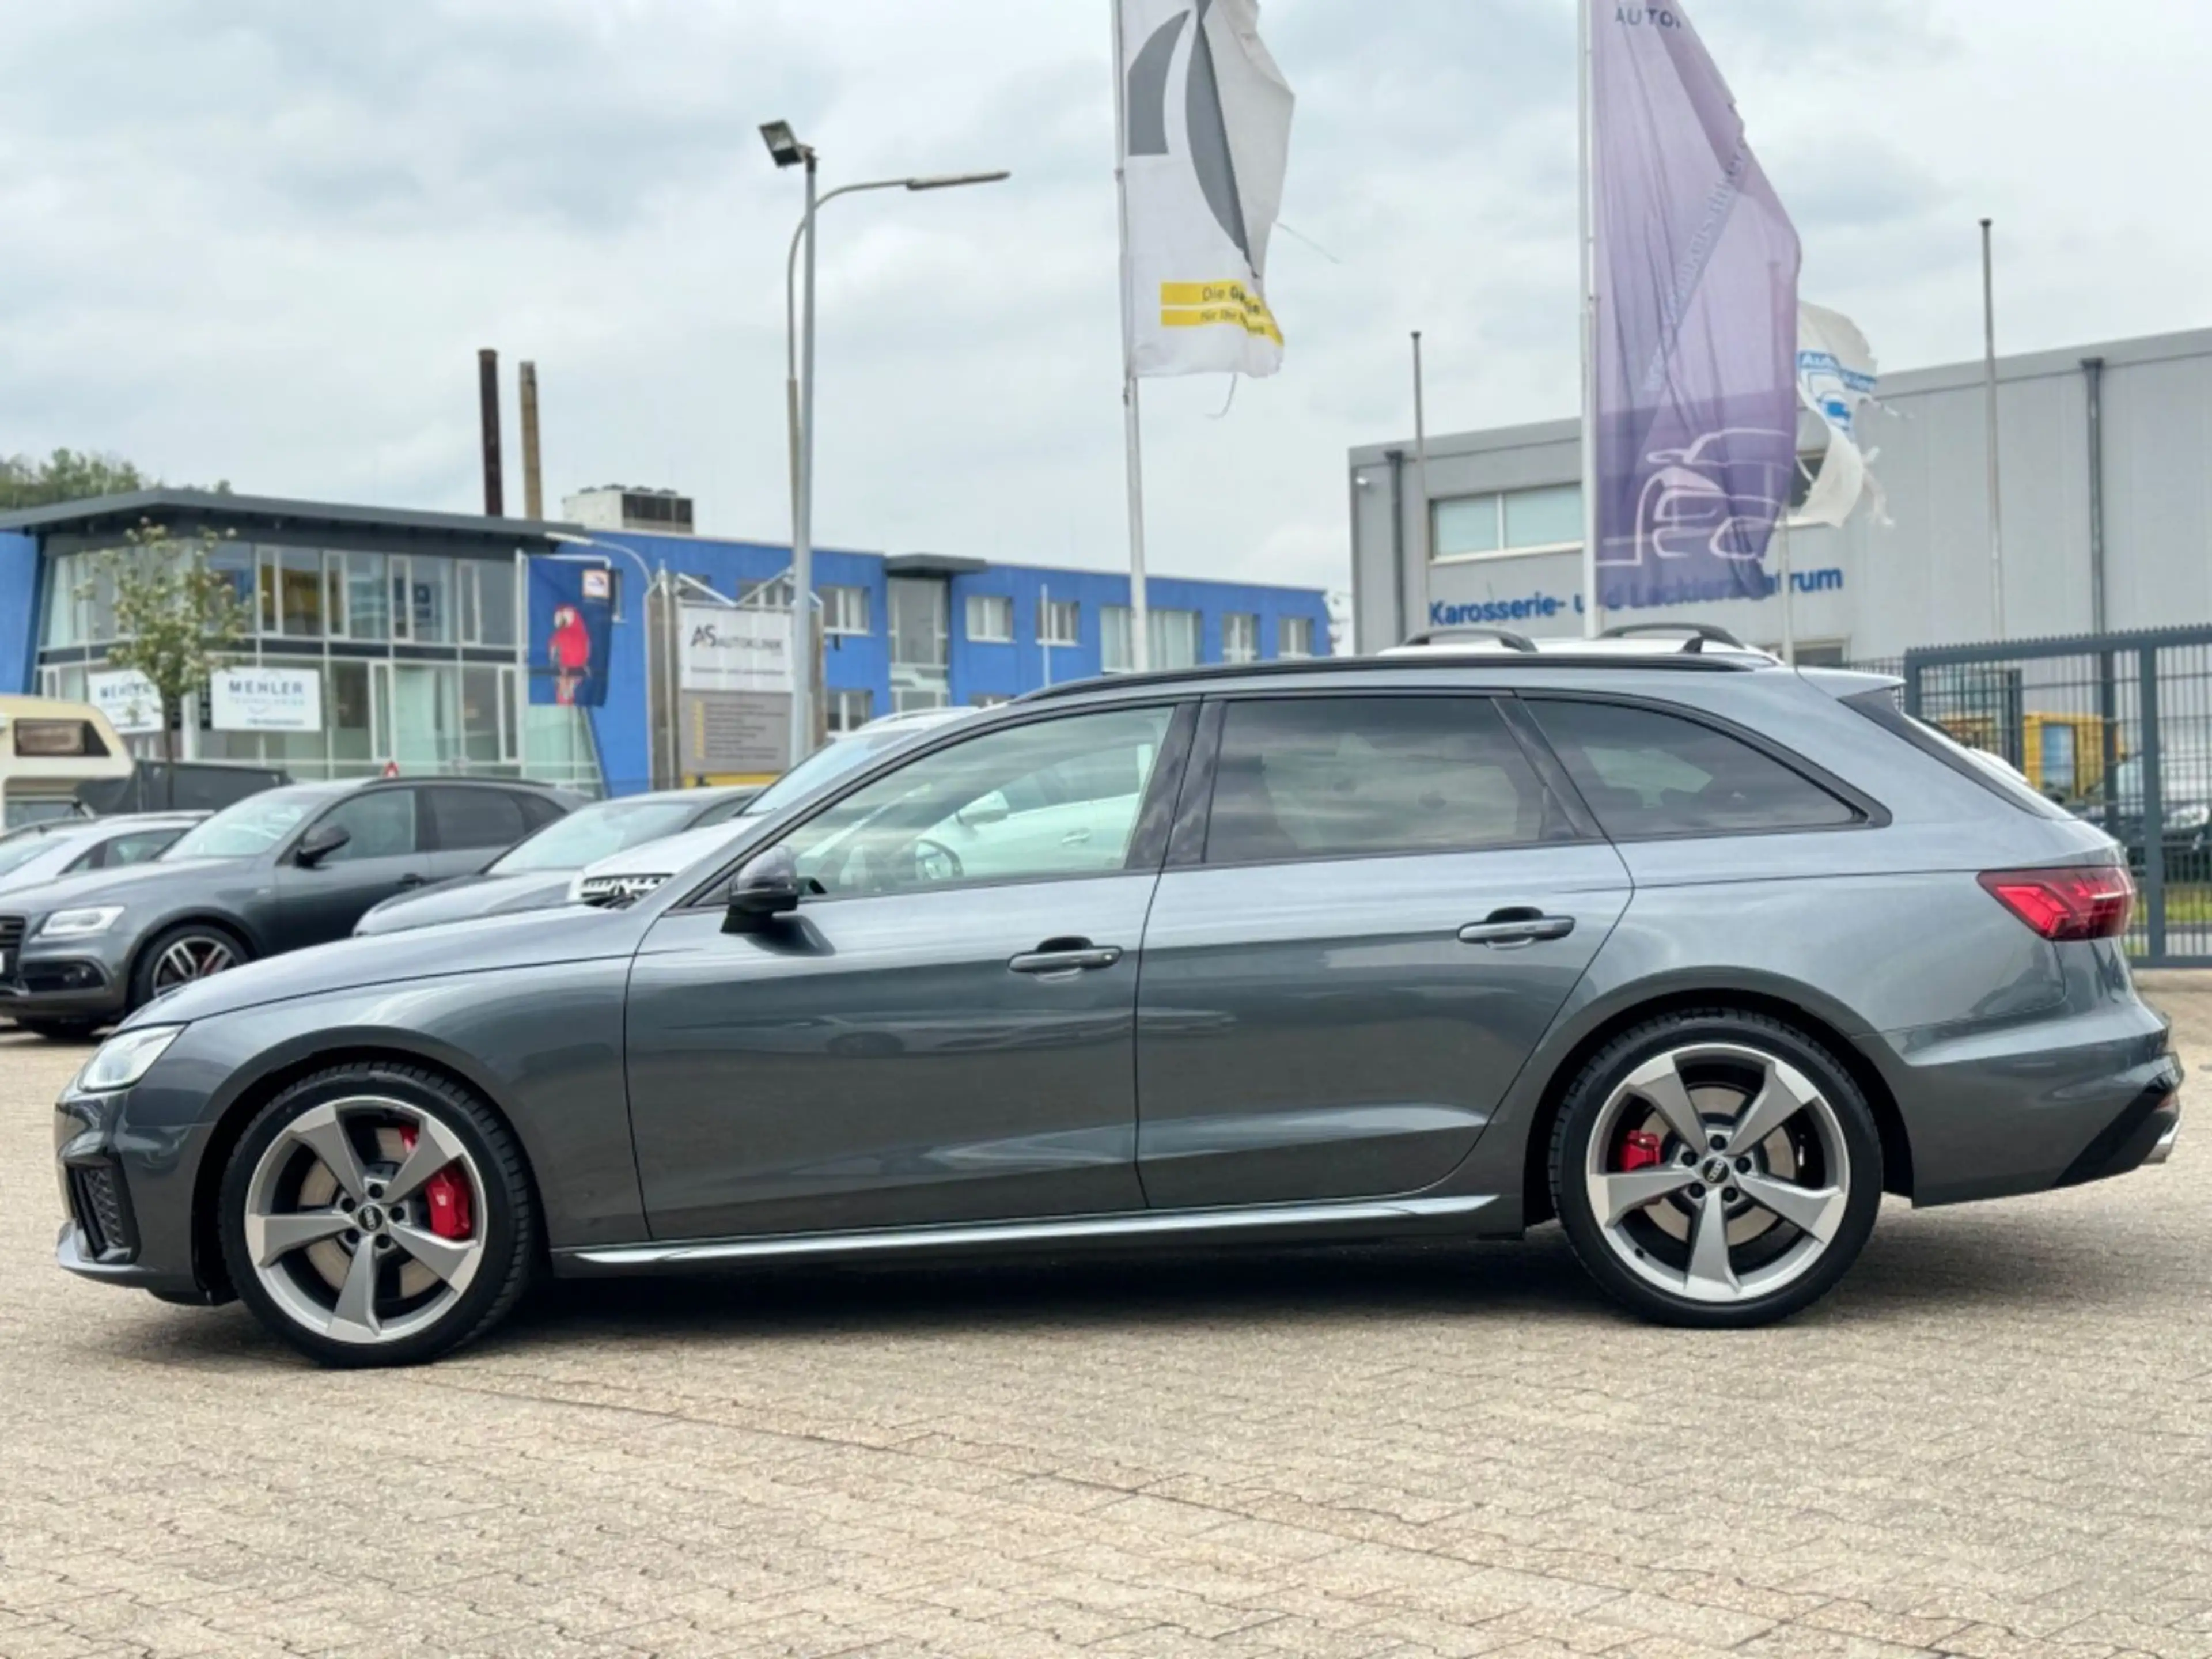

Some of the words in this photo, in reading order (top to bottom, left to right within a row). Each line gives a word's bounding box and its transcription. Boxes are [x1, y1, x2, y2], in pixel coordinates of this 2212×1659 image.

[1430, 591, 1567, 627] Karosserie-
[691, 625, 716, 647] AS
[229, 680, 304, 695] MEHLER
